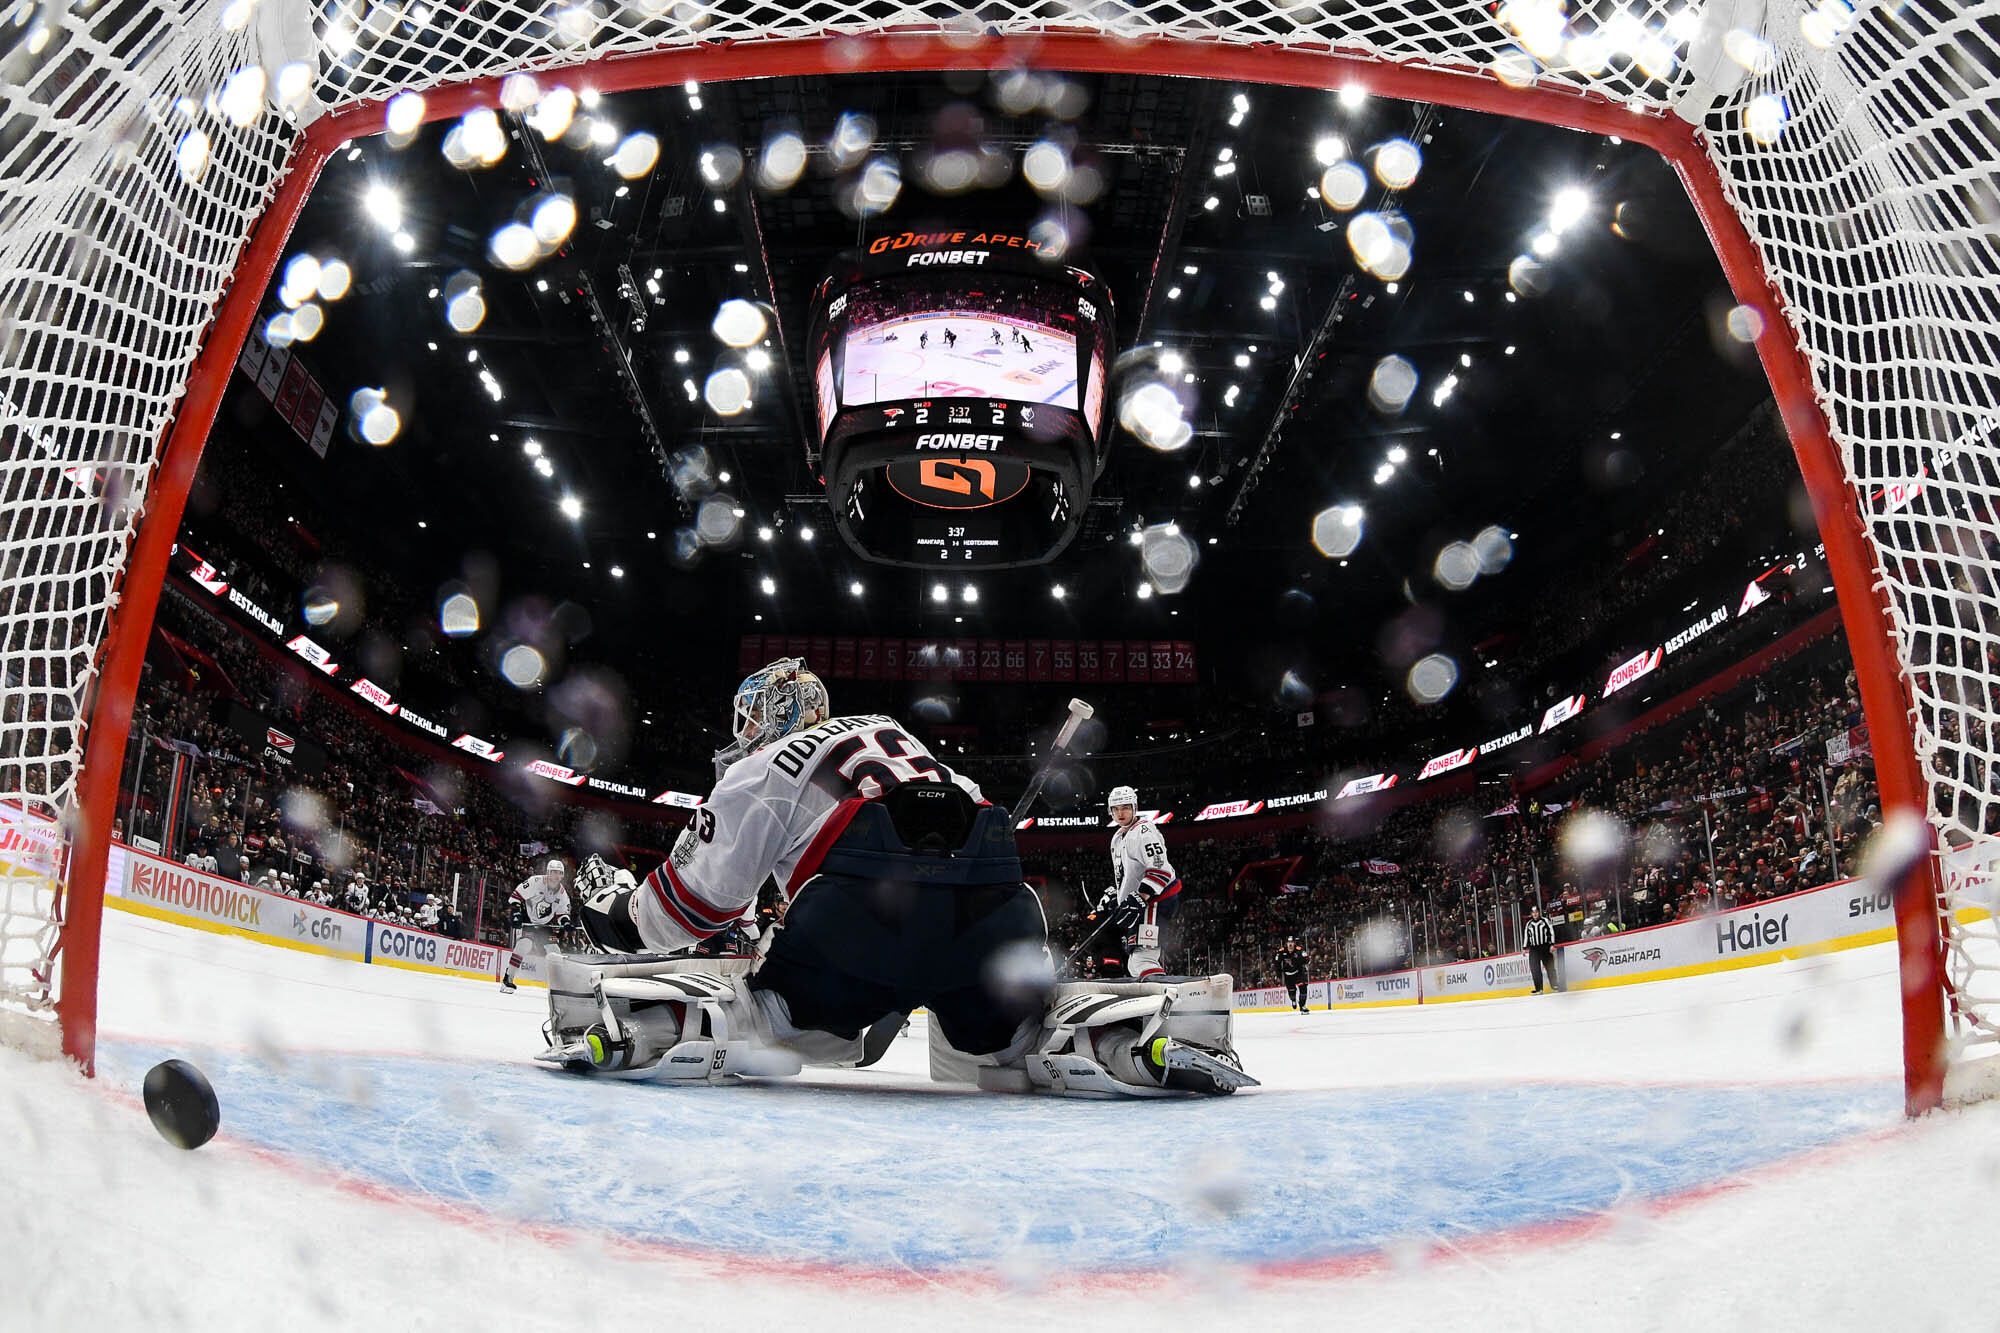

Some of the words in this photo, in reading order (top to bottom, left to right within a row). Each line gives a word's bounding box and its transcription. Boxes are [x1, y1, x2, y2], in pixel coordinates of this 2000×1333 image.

[907, 251, 990, 267] FONBET
[828, 293, 847, 314] FON
[1078, 297, 1097, 316] FON
[916, 408, 928, 424] 2
[949, 407, 970, 417] 3:37
[992, 409, 1005, 425] 2
[915, 433, 1003, 451] FONBET
[948, 526, 965, 537] 3:37
[941, 550, 948, 559] 2
[965, 550, 972, 559] 2
[1796, 552, 1807, 570] 2
[229, 588, 284, 636] BEST.KHL.RU
[1664, 605, 1728, 655] BEST.KHL.RU
[1611, 658, 1644, 687] FONBET
[361, 682, 387, 705] FONBET
[400, 706, 448, 738] BEST.KHL.RU
[1480, 723, 1533, 755] BEST.KHL.RU
[534, 763, 568, 779] FONBET
[1428, 754, 1459, 773] FONBET
[589, 778, 646, 798] BEST.KHL.RU
[917, 791, 946, 799] CCM
[1267, 790, 1328, 809] BEST.KHL.RU
[1206, 804, 1243, 817] FONBET
[1037, 816, 1099, 827] BEST.KHL.RU
[1145, 842, 1164, 858] 55
[131, 860, 263, 926] КИНОПОИСК
[311, 917, 342, 942] сбп
[1716, 913, 1789, 954] Haier
[444, 944, 494, 971] FONBET
[1608, 948, 1661, 966] АВАНГАРД
[1446, 973, 1468, 985] БАНК
[1264, 991, 1287, 1005] FONBET
